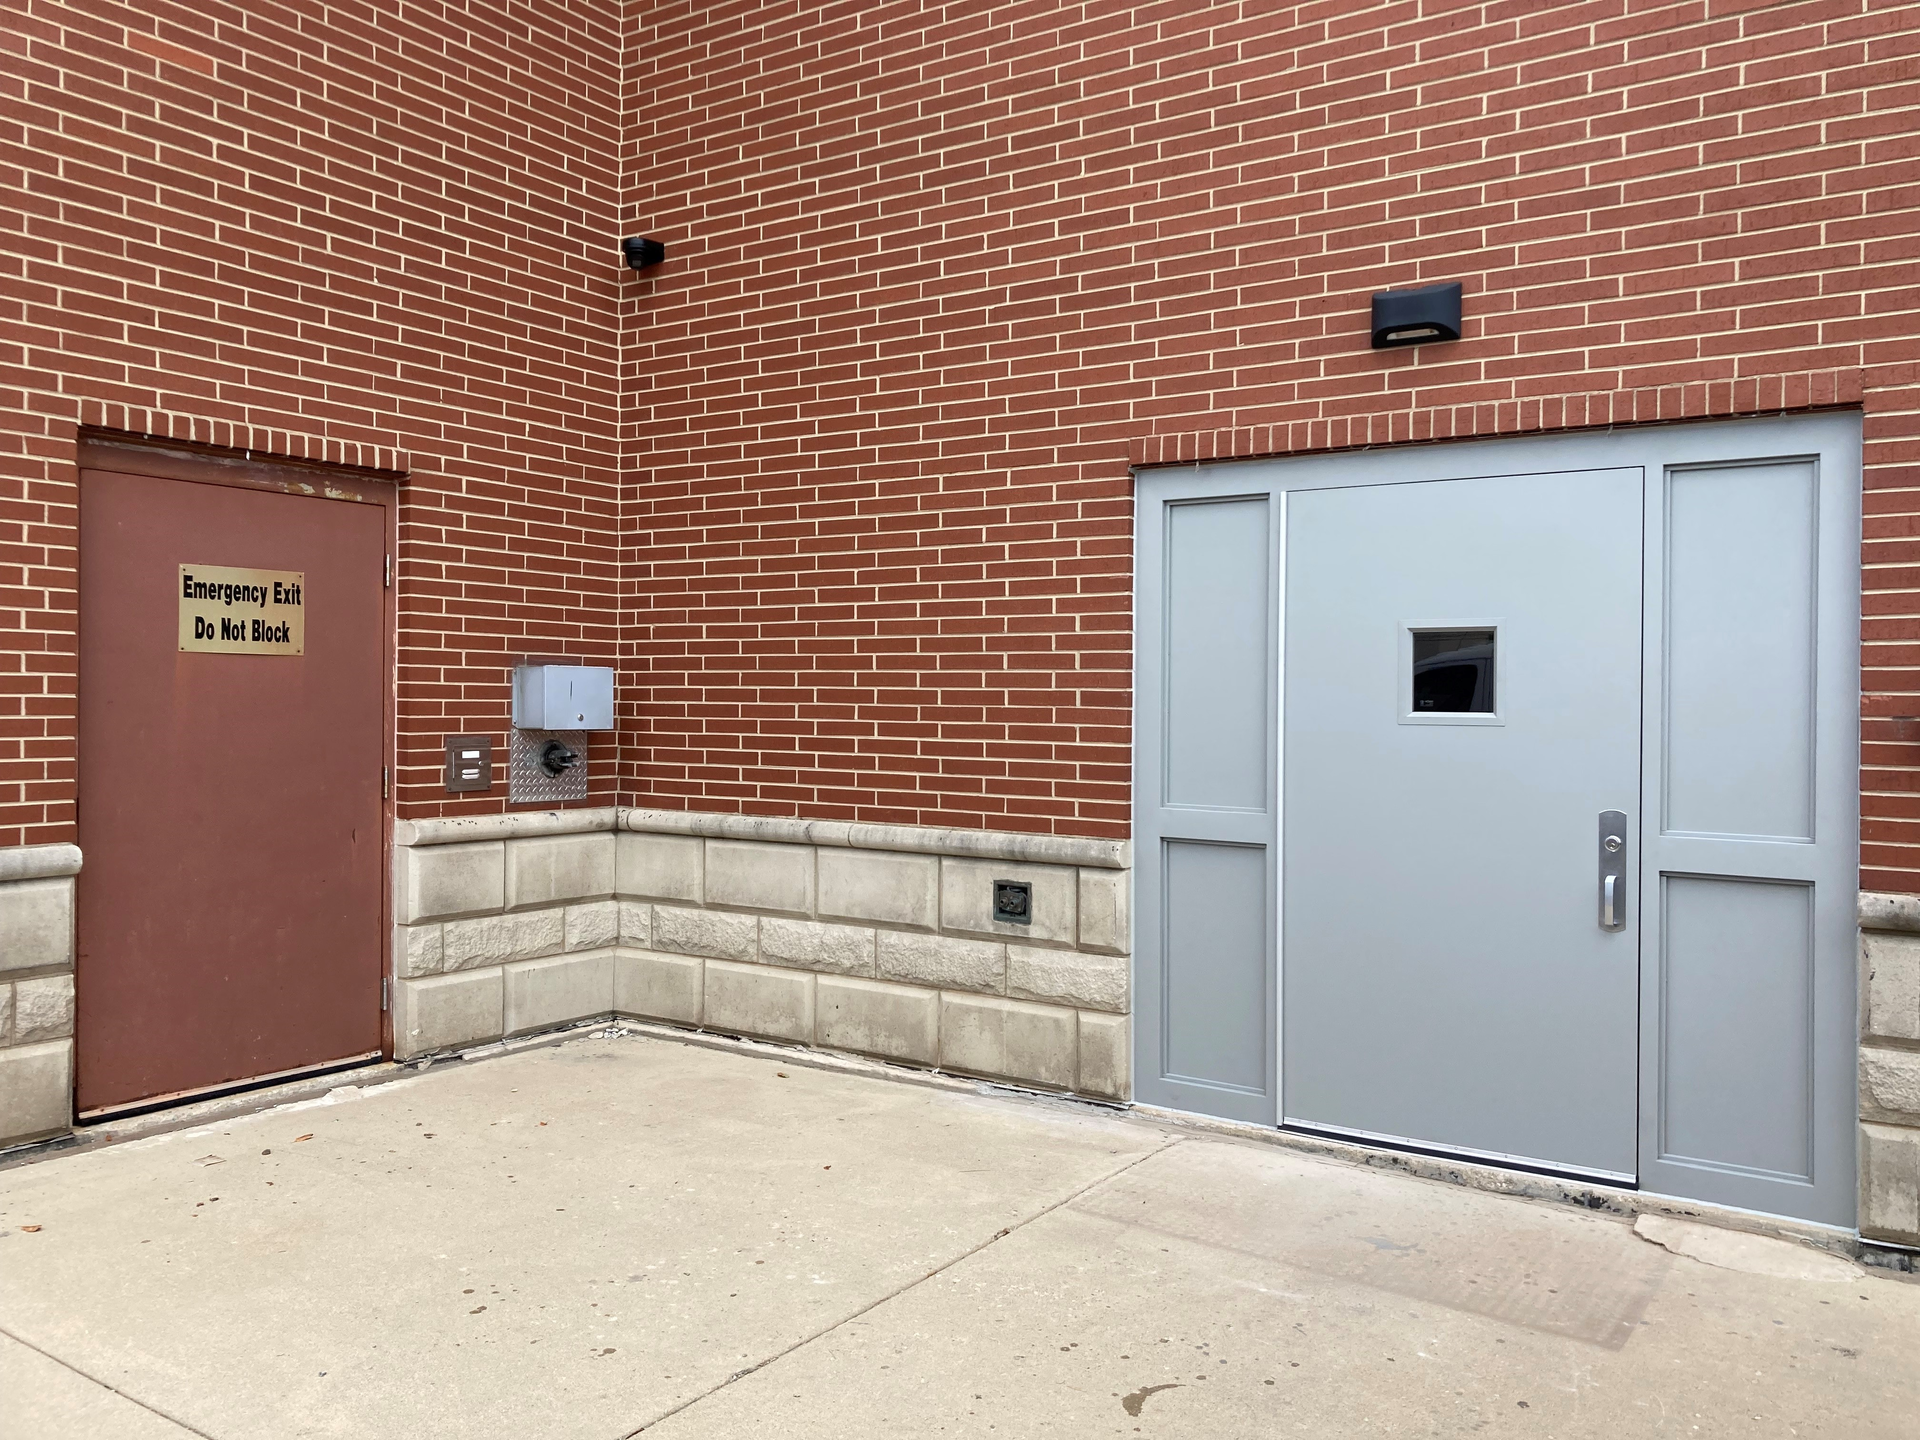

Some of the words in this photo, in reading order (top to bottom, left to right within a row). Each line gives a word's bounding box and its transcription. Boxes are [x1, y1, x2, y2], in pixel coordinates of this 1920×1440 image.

[183, 574, 268, 608] Emergency
[273, 581, 301, 605] Exit
[194, 616, 215, 640] Do
[221, 617, 246, 641] Not
[251, 619, 290, 643] Block
